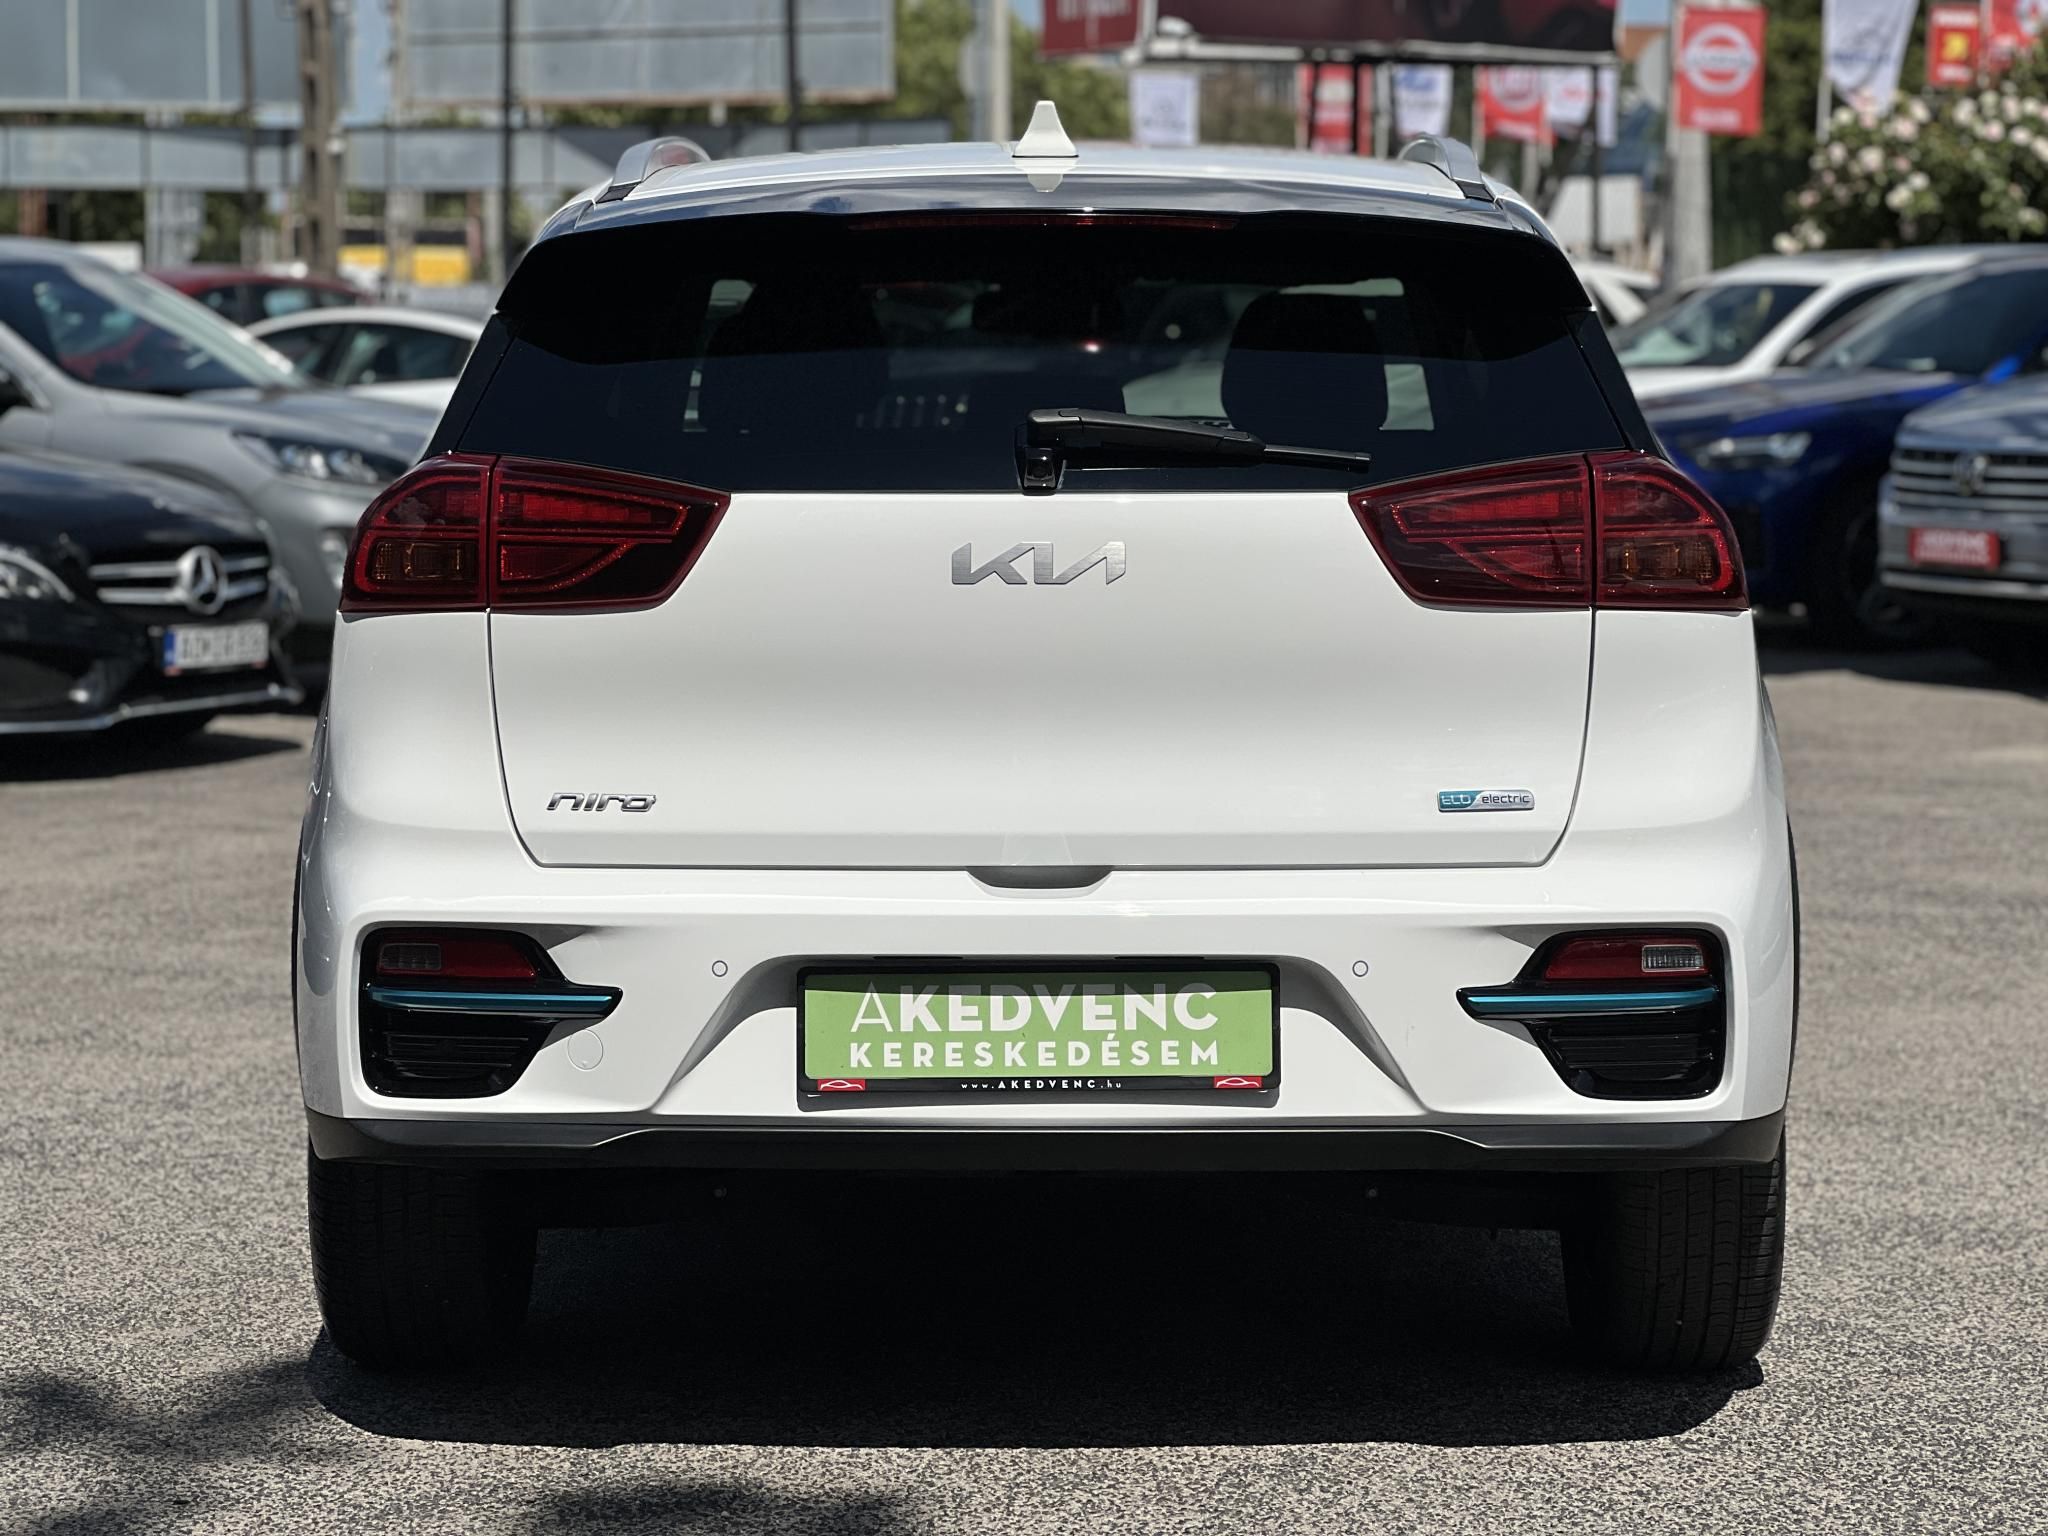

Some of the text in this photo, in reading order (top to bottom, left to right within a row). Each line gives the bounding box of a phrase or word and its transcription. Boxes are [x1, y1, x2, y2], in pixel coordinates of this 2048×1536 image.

[951, 541, 1127, 585] KIA
[1441, 793, 1530, 805] ECO electric
[849, 1033, 1219, 1068] KERESKEDÉSEM
[961, 1079, 1122, 1089] www.AKEDVENC.hu
